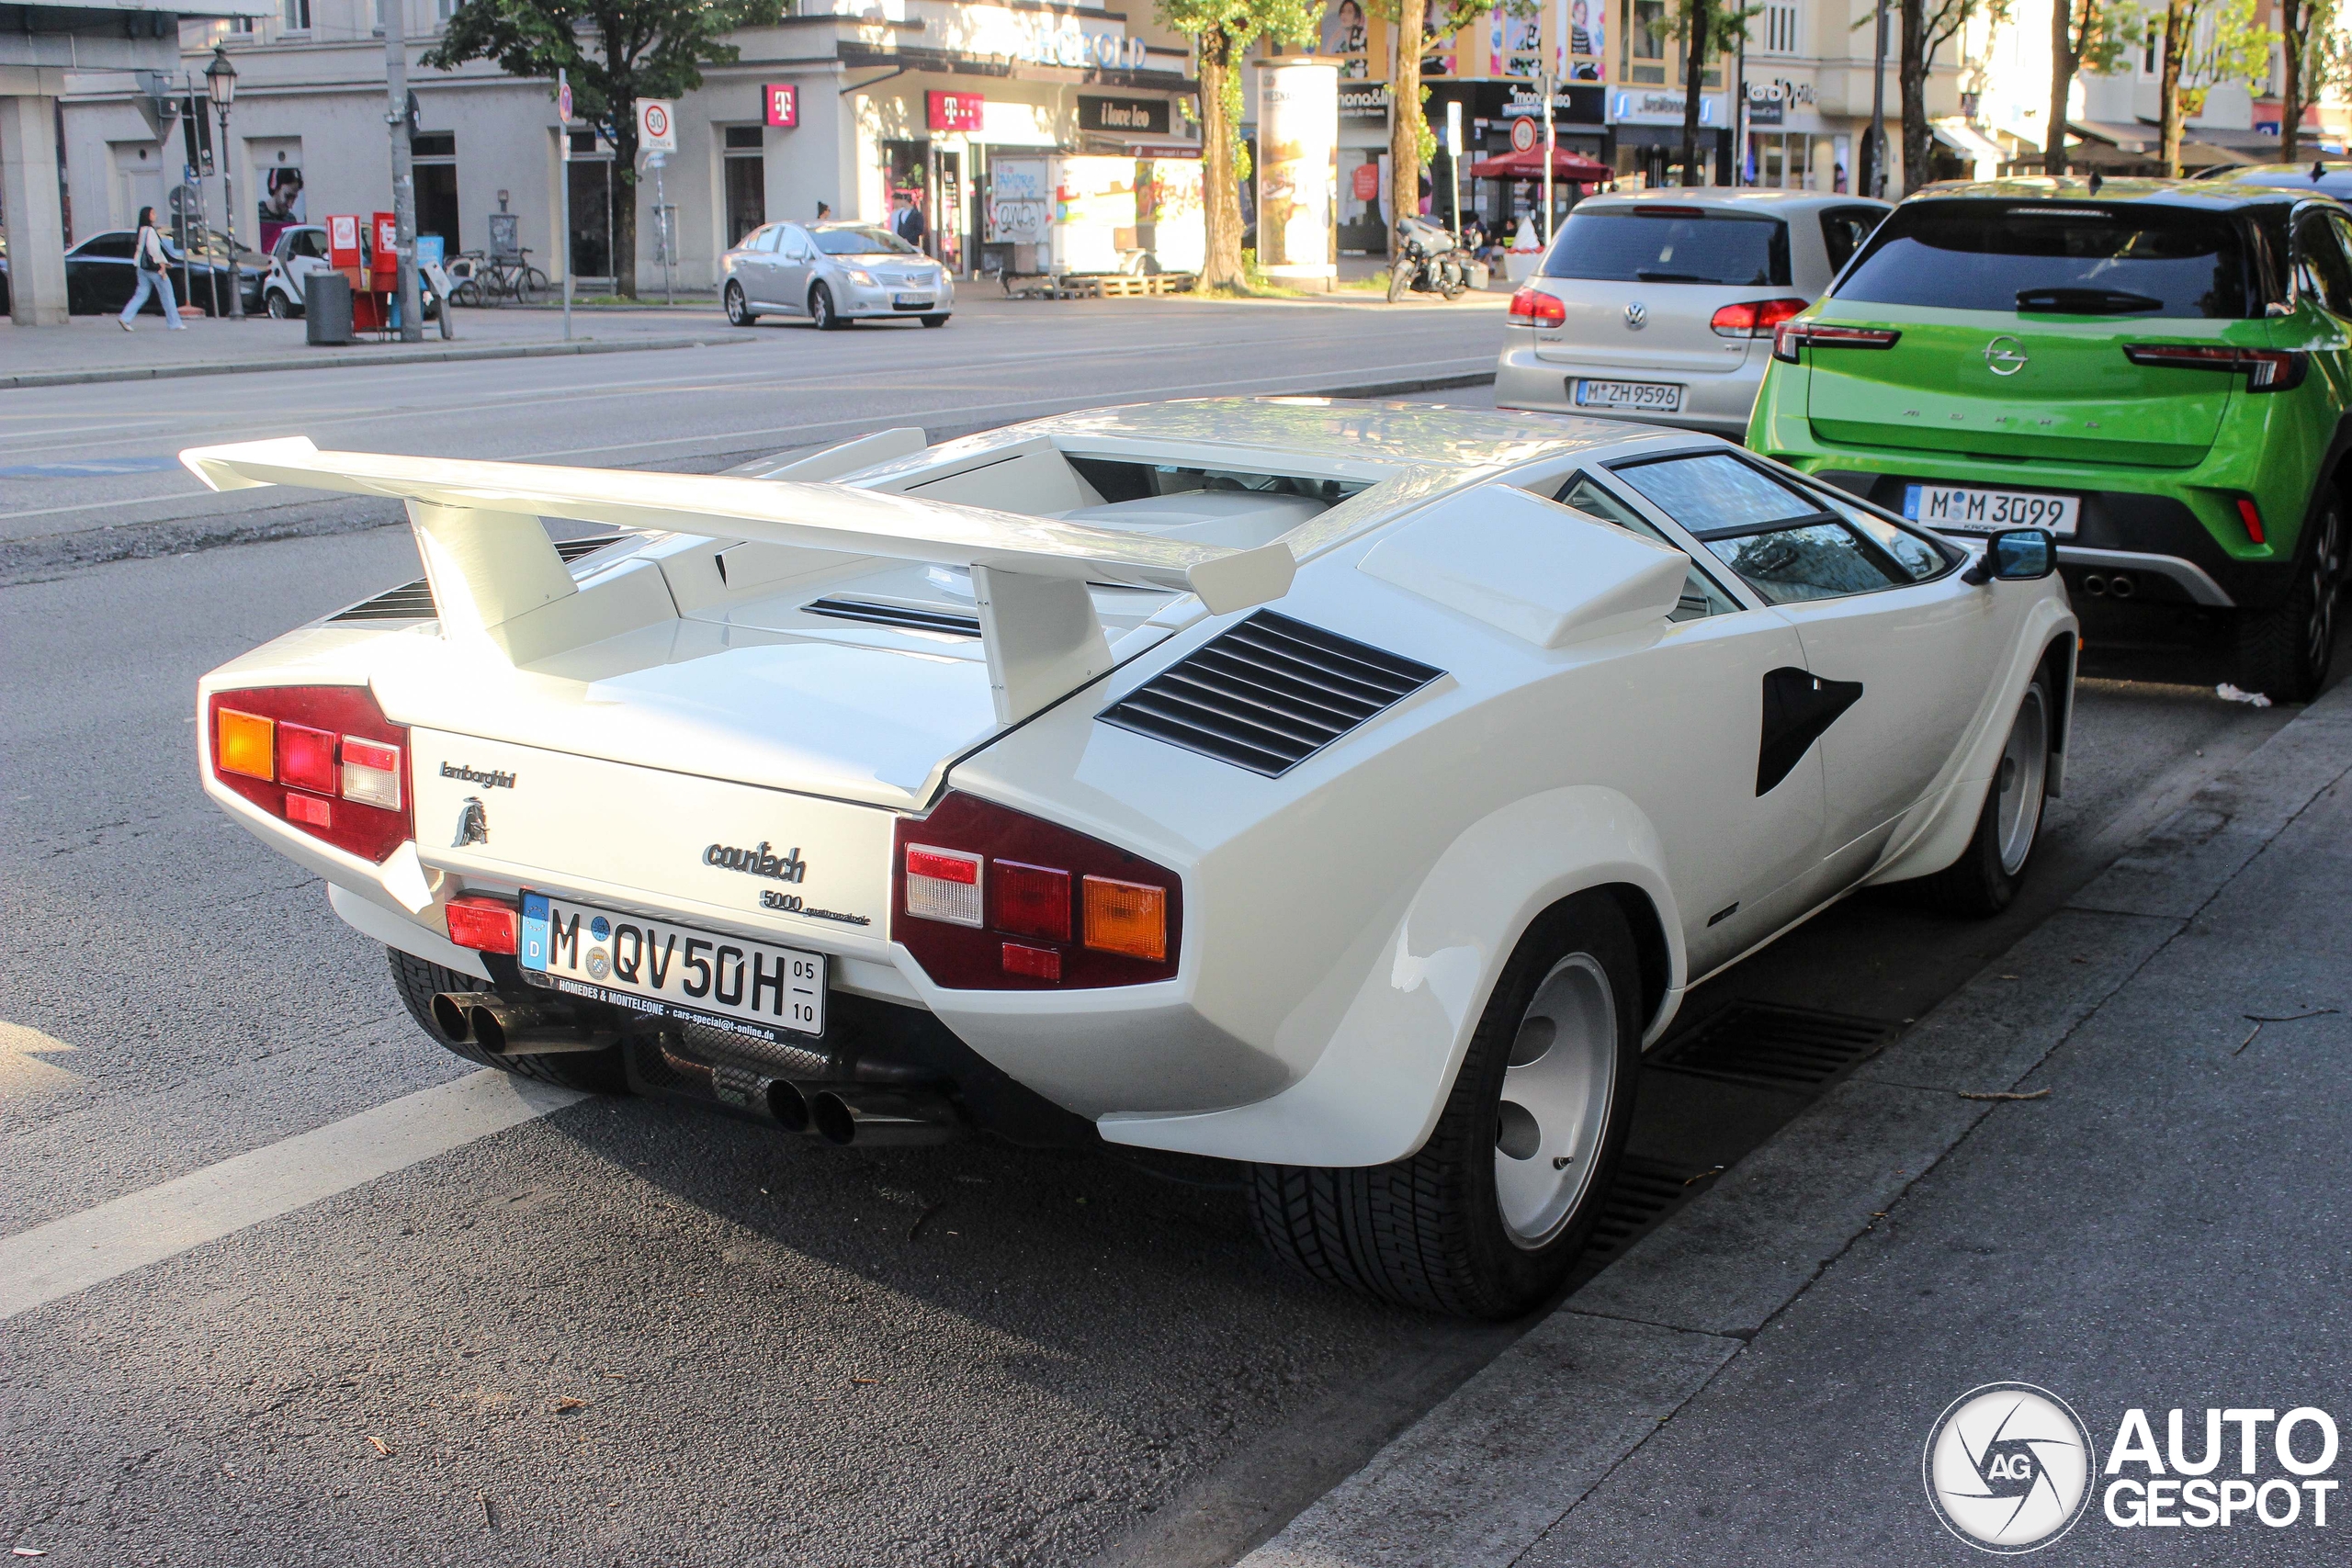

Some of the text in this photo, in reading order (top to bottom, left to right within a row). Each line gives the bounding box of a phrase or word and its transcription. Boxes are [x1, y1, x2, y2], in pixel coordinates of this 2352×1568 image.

[1020, 27, 1146, 70] LEOPOLD
[649, 112, 663, 129] 30
[1132, 104, 1150, 128] leo
[1588, 384, 1599, 400] M
[1930, 491, 1949, 517] M
[1992, 496, 2064, 527] 3099
[439, 761, 516, 789] lamborghini
[702, 840, 807, 884] countach
[759, 889, 802, 912] 5000
[529, 940, 540, 957] D
[550, 908, 580, 970] M
[793, 961, 814, 980] 05
[559, 979, 775, 1041] HOMEDES & MONTELEONE cars-special@t-online.de
[794, 1003, 813, 1021] 10
